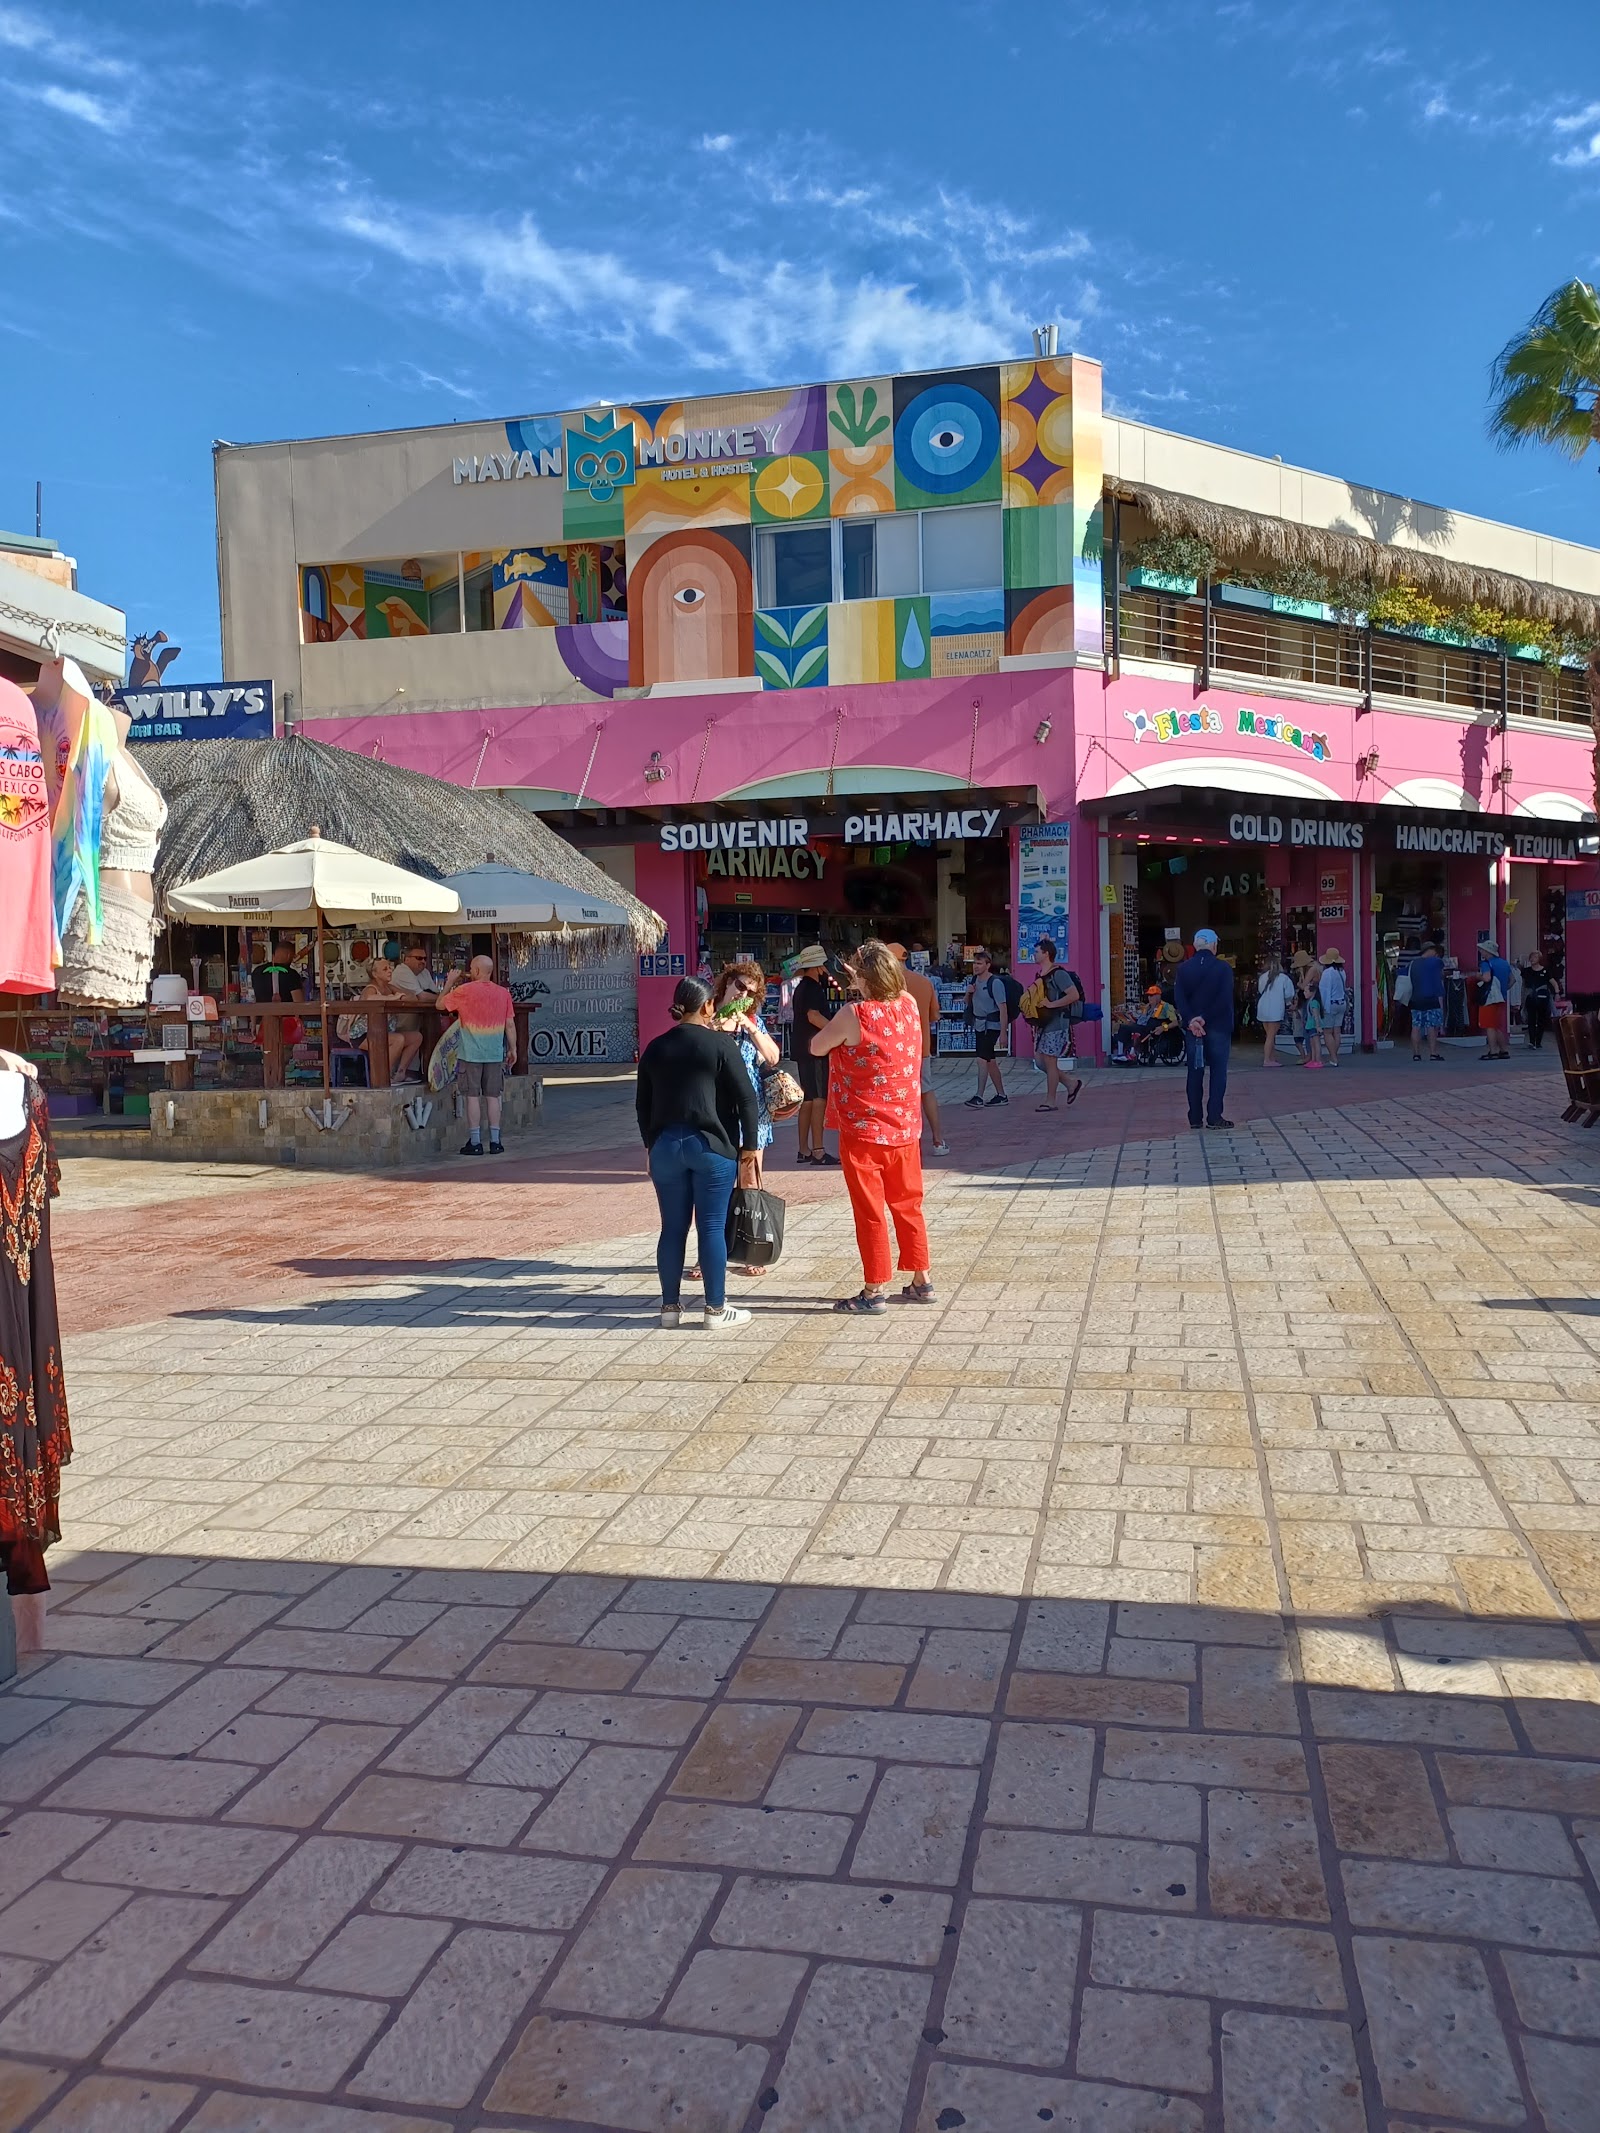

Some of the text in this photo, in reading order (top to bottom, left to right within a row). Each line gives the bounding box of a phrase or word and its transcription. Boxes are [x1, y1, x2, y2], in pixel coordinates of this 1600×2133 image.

[453, 424, 781, 485] MAYAN MONKEY
[661, 462, 757, 481] HOTEL & HOSTEL
[123, 687, 264, 720] WILLY'S
[128, 722, 182, 738] UTRI BAR
[1153, 705, 1325, 762] Fiesta Mexicana
[9, 763, 43, 779] CABO
[660, 809, 1000, 851] SOUVENIR PHARMACY
[1021, 826, 1068, 839] PHARMACY
[1229, 813, 1364, 848] COLD DRINKS
[1396, 825, 1577, 860] HANDCRAFTS TEQUILA
[707, 847, 826, 880] ARMACY
[1203, 872, 1266, 897] CASH
[228, 895, 260, 908] PACIFICO
[466, 908, 497, 920] PACIFICO
[552, 997, 623, 1015] AND MORE
[530, 1029, 608, 1058] OME
